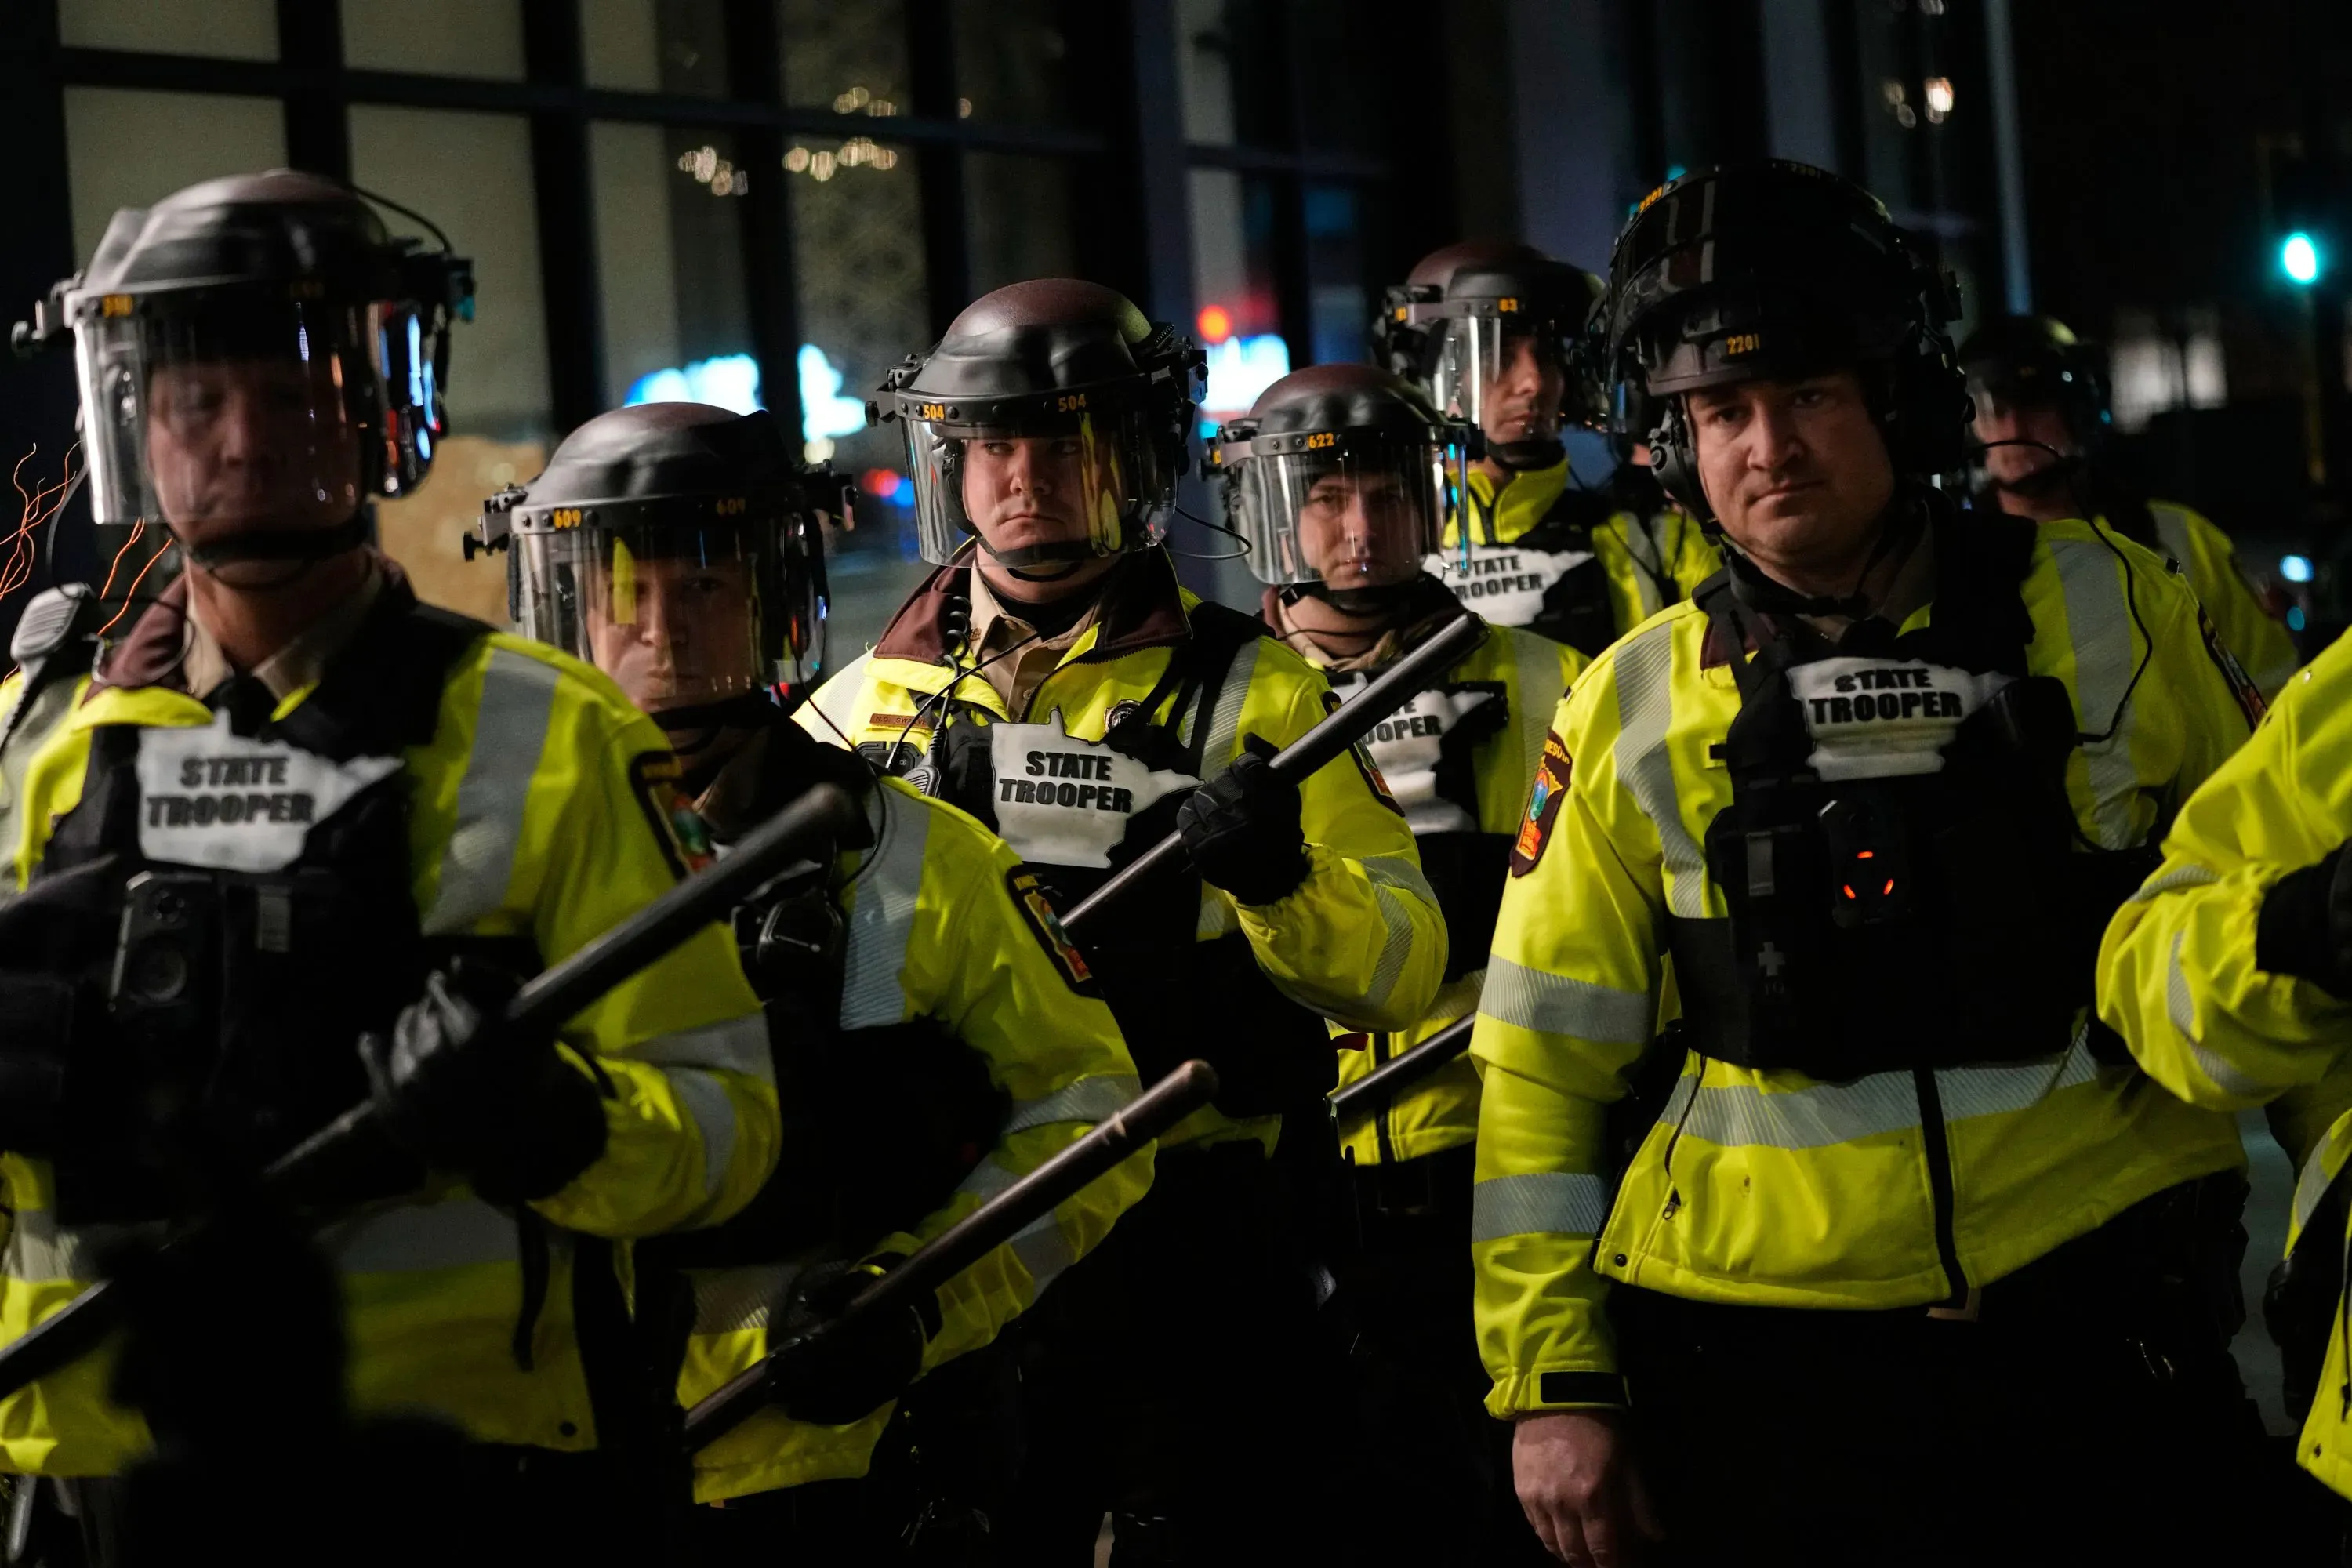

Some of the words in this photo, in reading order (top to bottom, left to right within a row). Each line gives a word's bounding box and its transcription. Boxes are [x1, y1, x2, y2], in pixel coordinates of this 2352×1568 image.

[1726, 332, 1760, 355] 2201
[924, 404, 945, 420] 504
[1058, 394, 1086, 412] 504
[1308, 432, 1335, 450] 622
[553, 509, 582, 530] 609
[716, 497, 746, 517] 609
[1453, 573, 1543, 601] ROOPER
[1834, 668, 1932, 692] STATE
[1809, 691, 1963, 724] TROOPER
[1363, 715, 1442, 746] OOPER
[180, 757, 288, 788] STATE
[1025, 750, 1112, 781] STATE
[999, 778, 1134, 814] TROOPER
[147, 793, 315, 827] TROOPER
